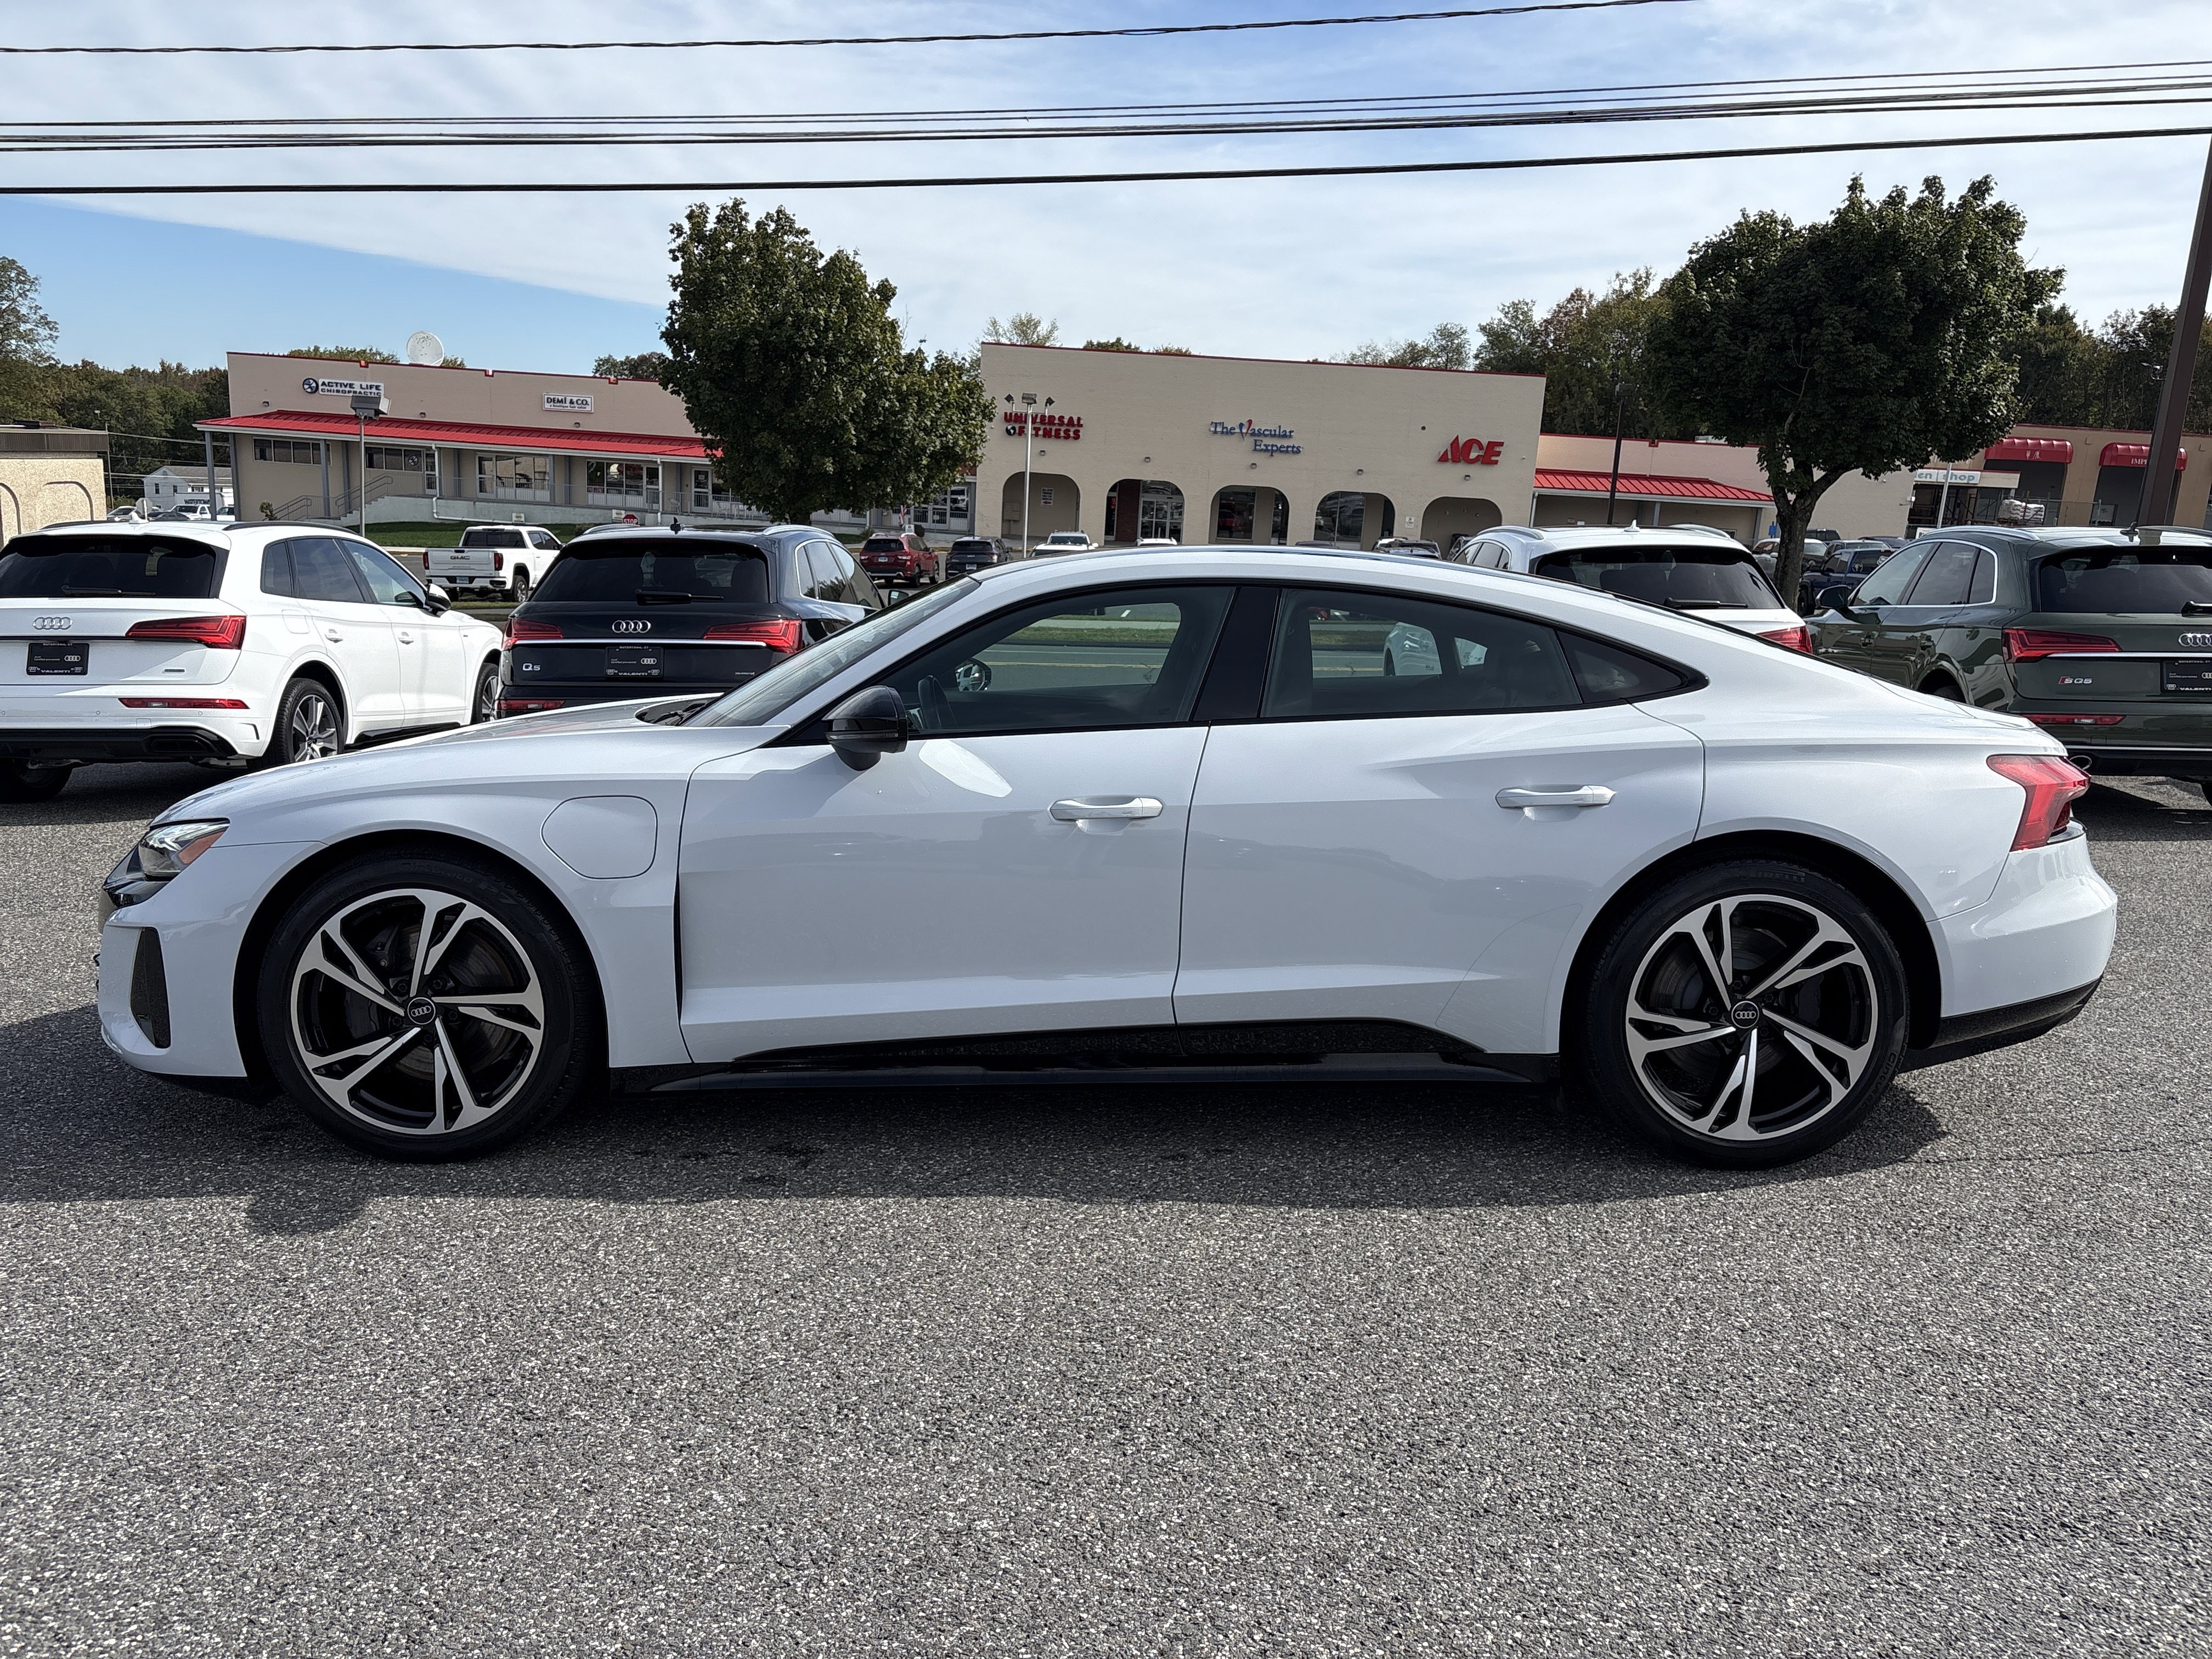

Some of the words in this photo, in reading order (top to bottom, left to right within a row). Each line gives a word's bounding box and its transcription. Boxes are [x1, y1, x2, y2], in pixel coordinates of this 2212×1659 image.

[321, 381, 355, 389] ACTIVE
[1004, 411, 1084, 427] UNIVERSAL
[1018, 426, 1080, 440] FTNESS
[1210, 421, 1235, 435] The
[1239, 419, 1294, 441] Vascular
[1252, 439, 1302, 456] Experts
[1437, 435, 1504, 465] ACE
[522, 663, 541, 671] Q5
